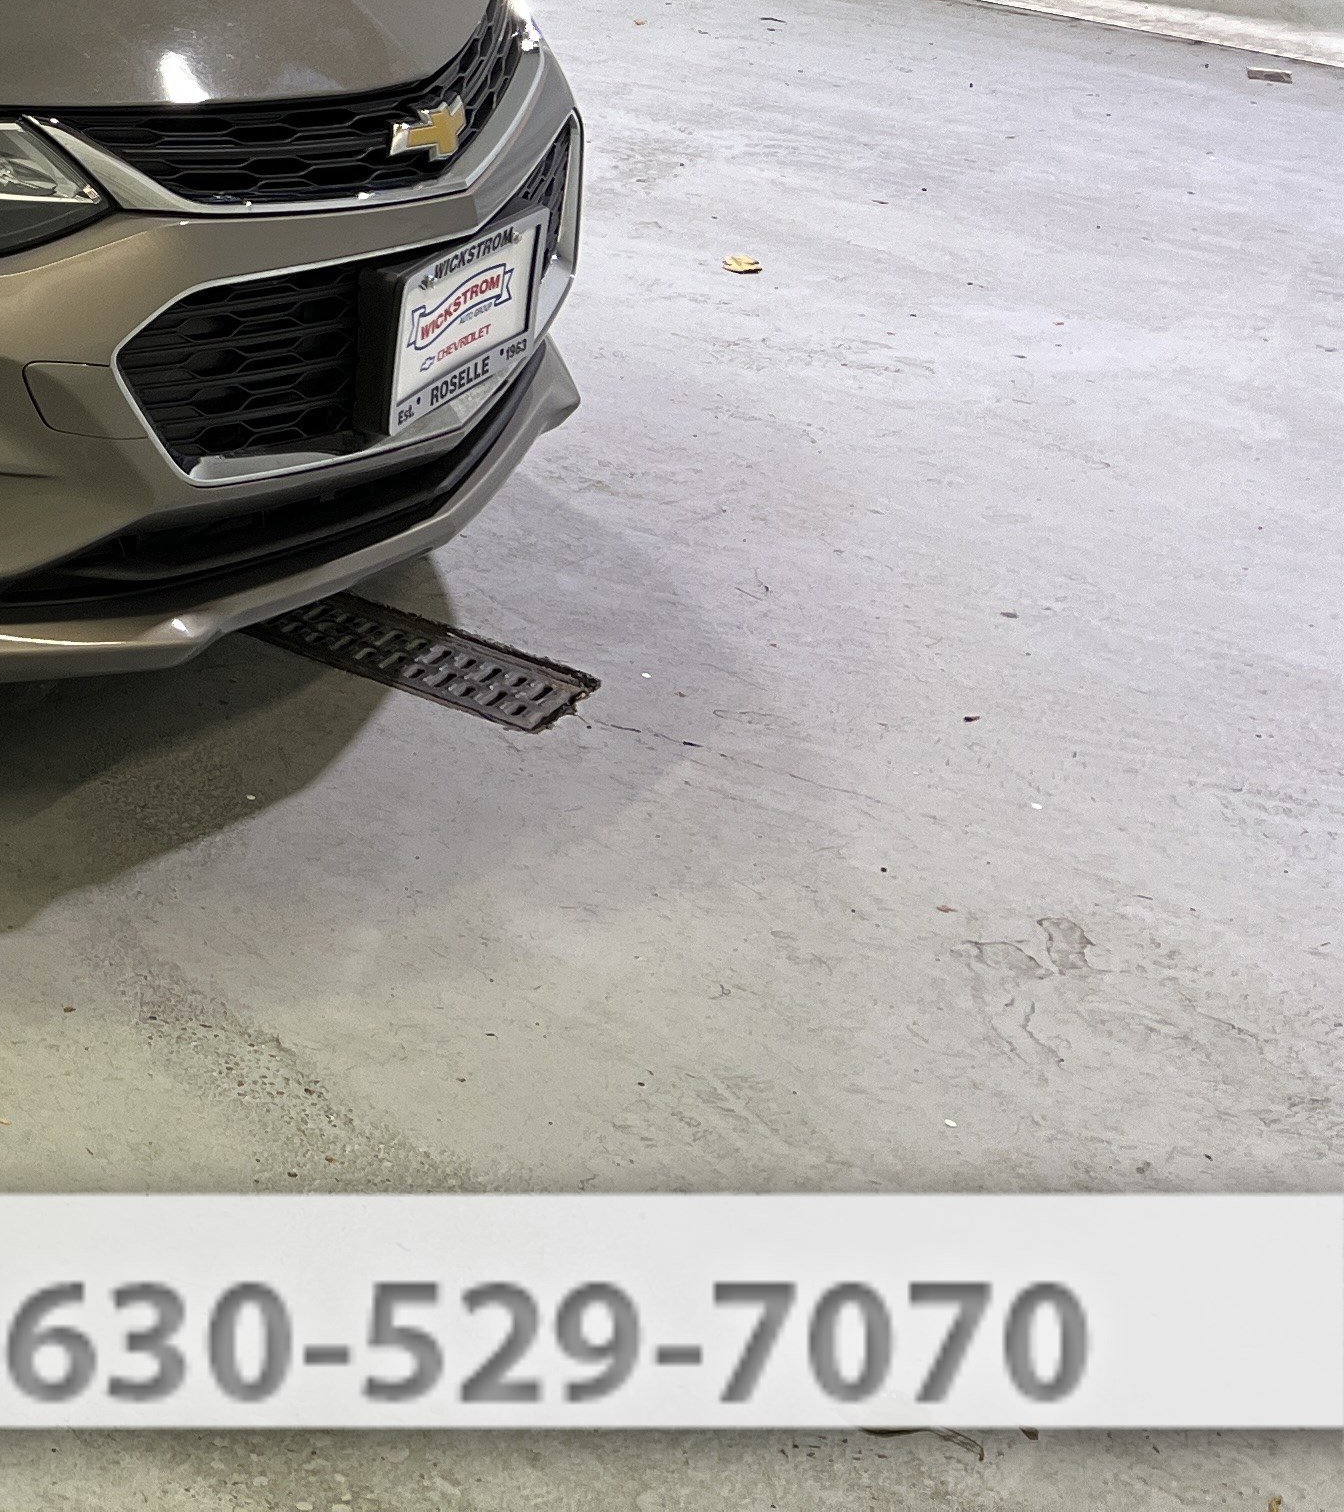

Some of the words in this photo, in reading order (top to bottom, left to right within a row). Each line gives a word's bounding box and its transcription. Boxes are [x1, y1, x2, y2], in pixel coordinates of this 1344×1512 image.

[433, 226, 514, 279] WICKSTROM
[419, 273, 501, 340] WICKSTROM
[436, 324, 492, 362] CHEVROLET
[397, 405, 415, 426] Est.
[429, 356, 491, 407] ROSELLE
